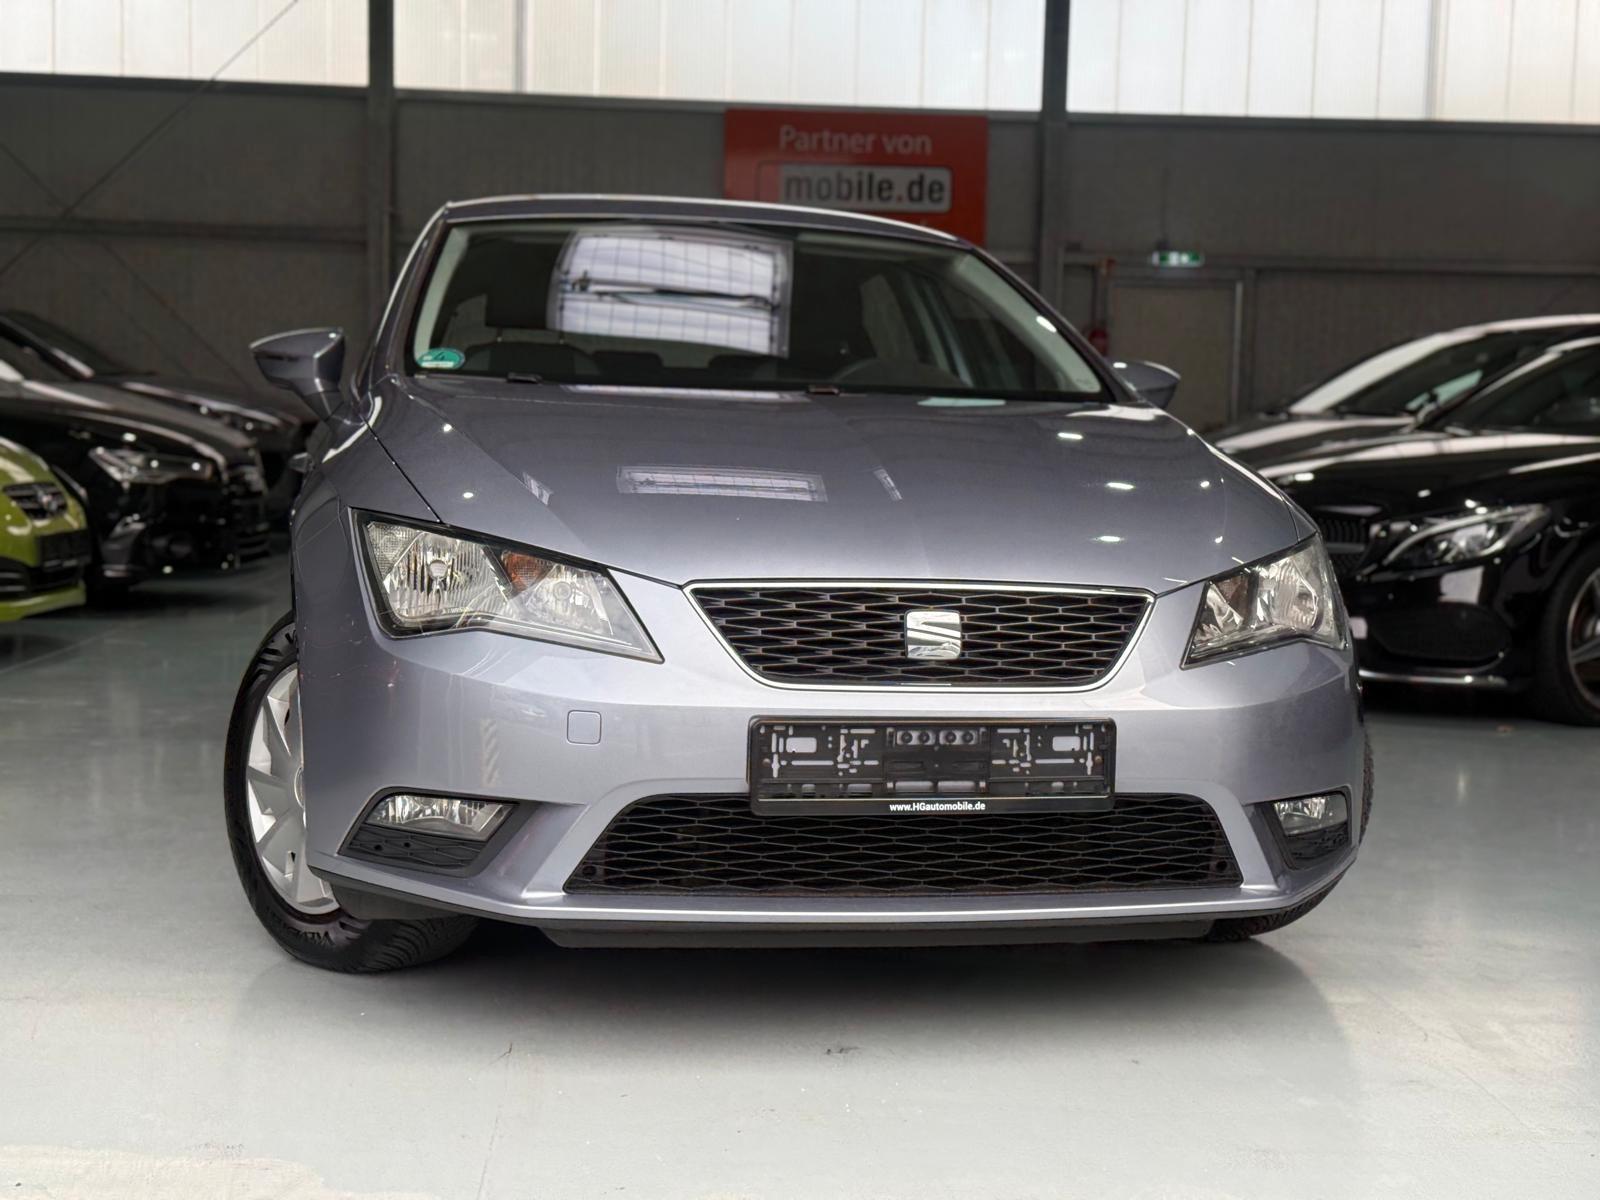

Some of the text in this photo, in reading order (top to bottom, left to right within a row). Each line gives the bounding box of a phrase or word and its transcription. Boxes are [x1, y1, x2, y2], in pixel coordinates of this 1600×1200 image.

[779, 125, 932, 155] Partner von
[784, 171, 946, 204] mobile.de
[889, 801, 986, 811] www.HGautomobile.de
